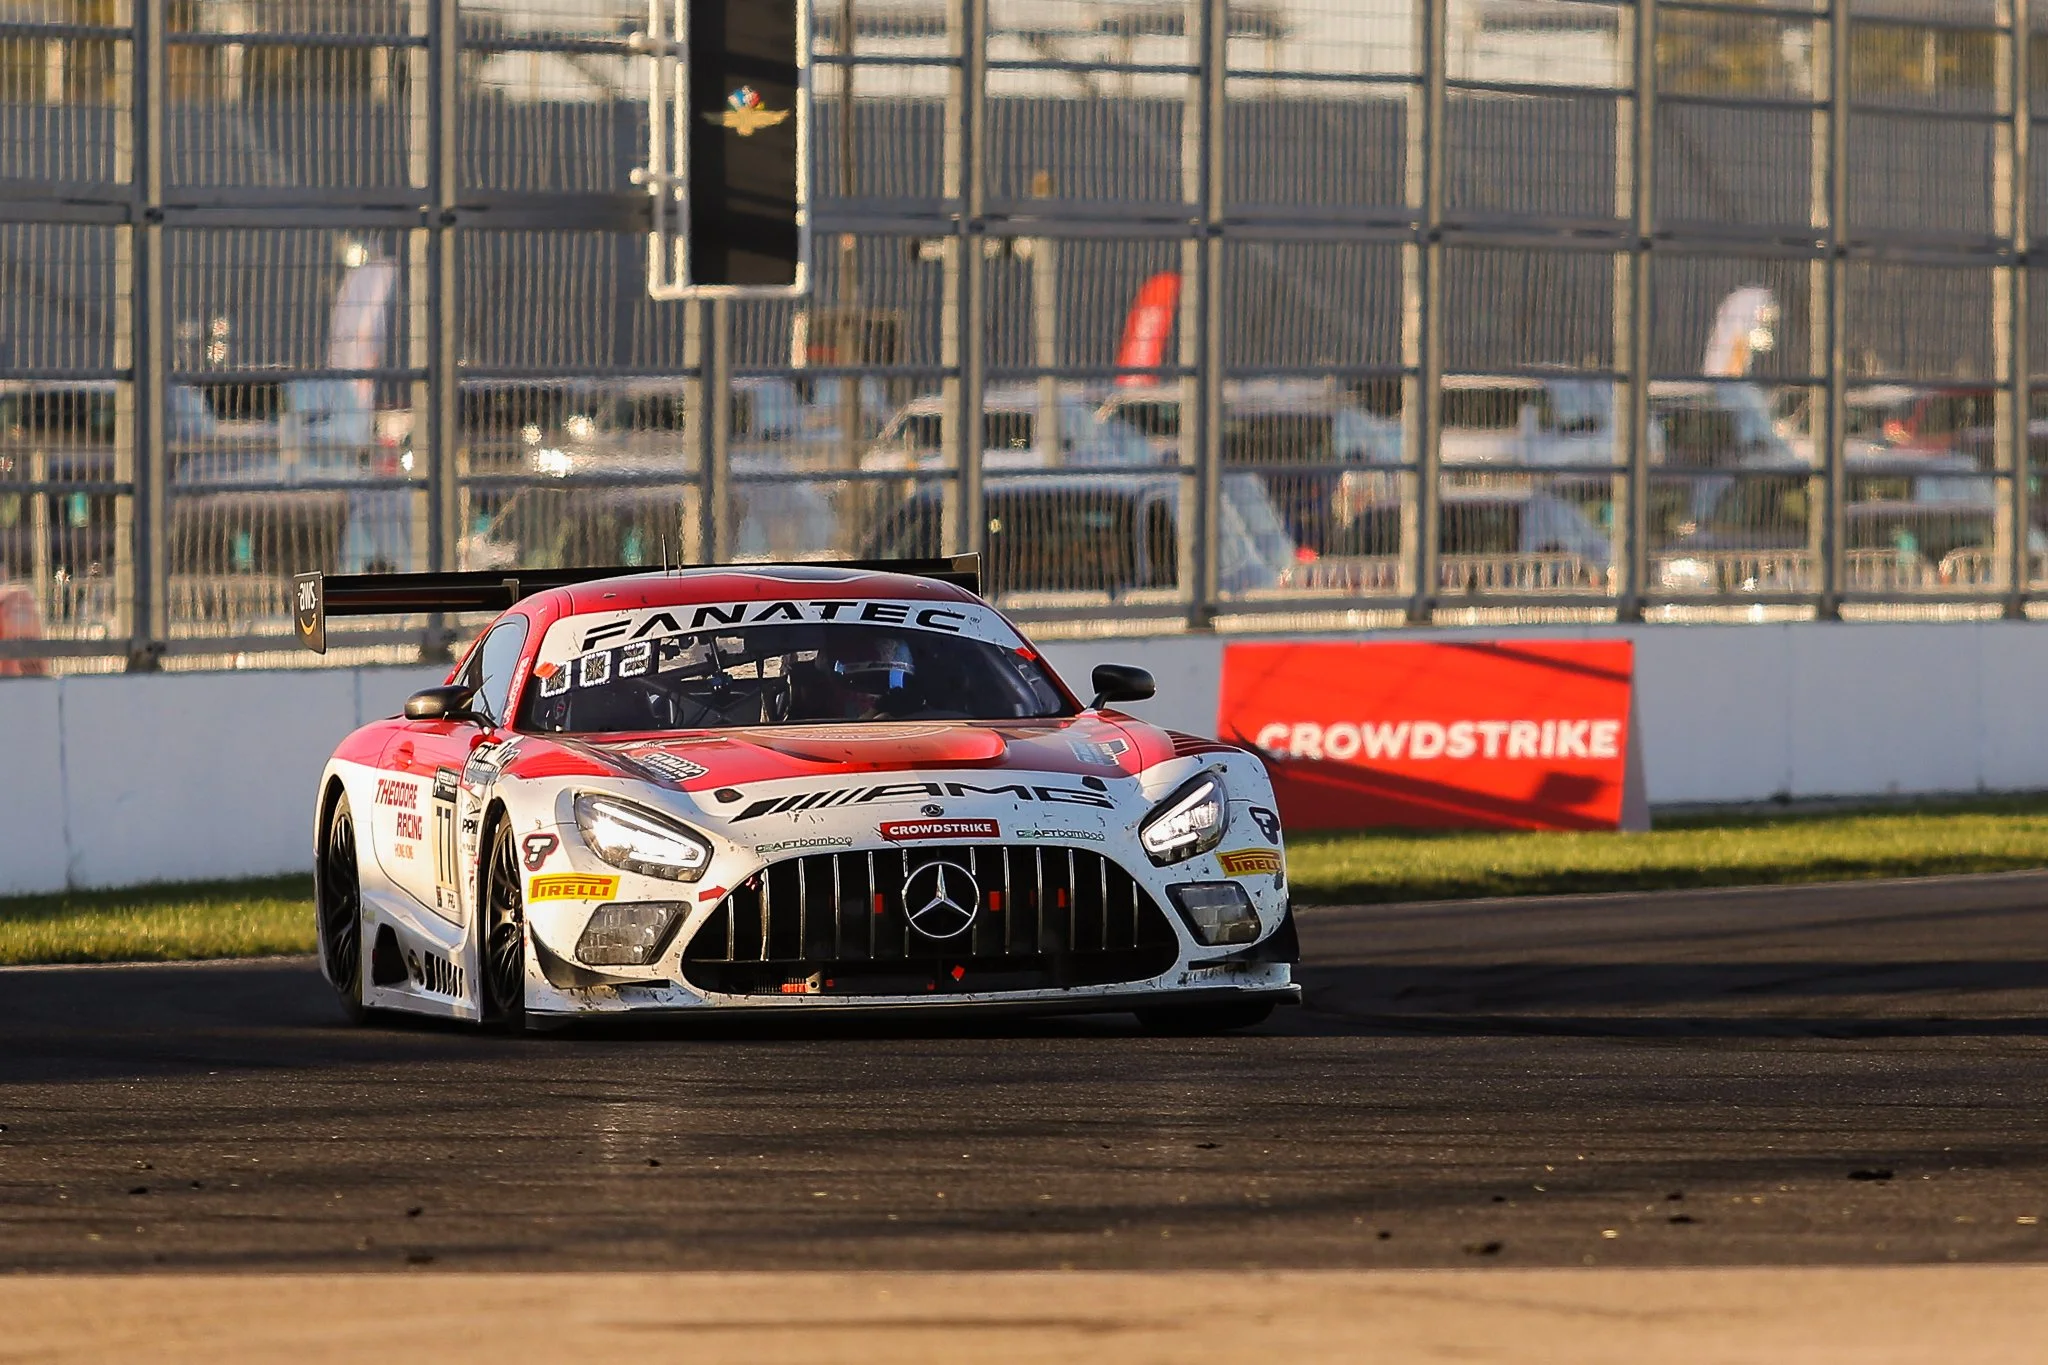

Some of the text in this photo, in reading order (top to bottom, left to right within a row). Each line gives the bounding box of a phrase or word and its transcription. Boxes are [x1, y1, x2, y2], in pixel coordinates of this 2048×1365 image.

[298, 581, 318, 611] aws
[582, 601, 966, 651] FANATEC
[1256, 719, 1621, 760] CROWDSTRIKE
[375, 779, 418, 810] THEODORE
[855, 783, 1115, 810] AMG
[396, 811, 422, 841] RACING
[889, 823, 992, 836] CROWDSTRIKE
[436, 806, 452, 885] 77
[532, 877, 612, 899] PIRELLI
